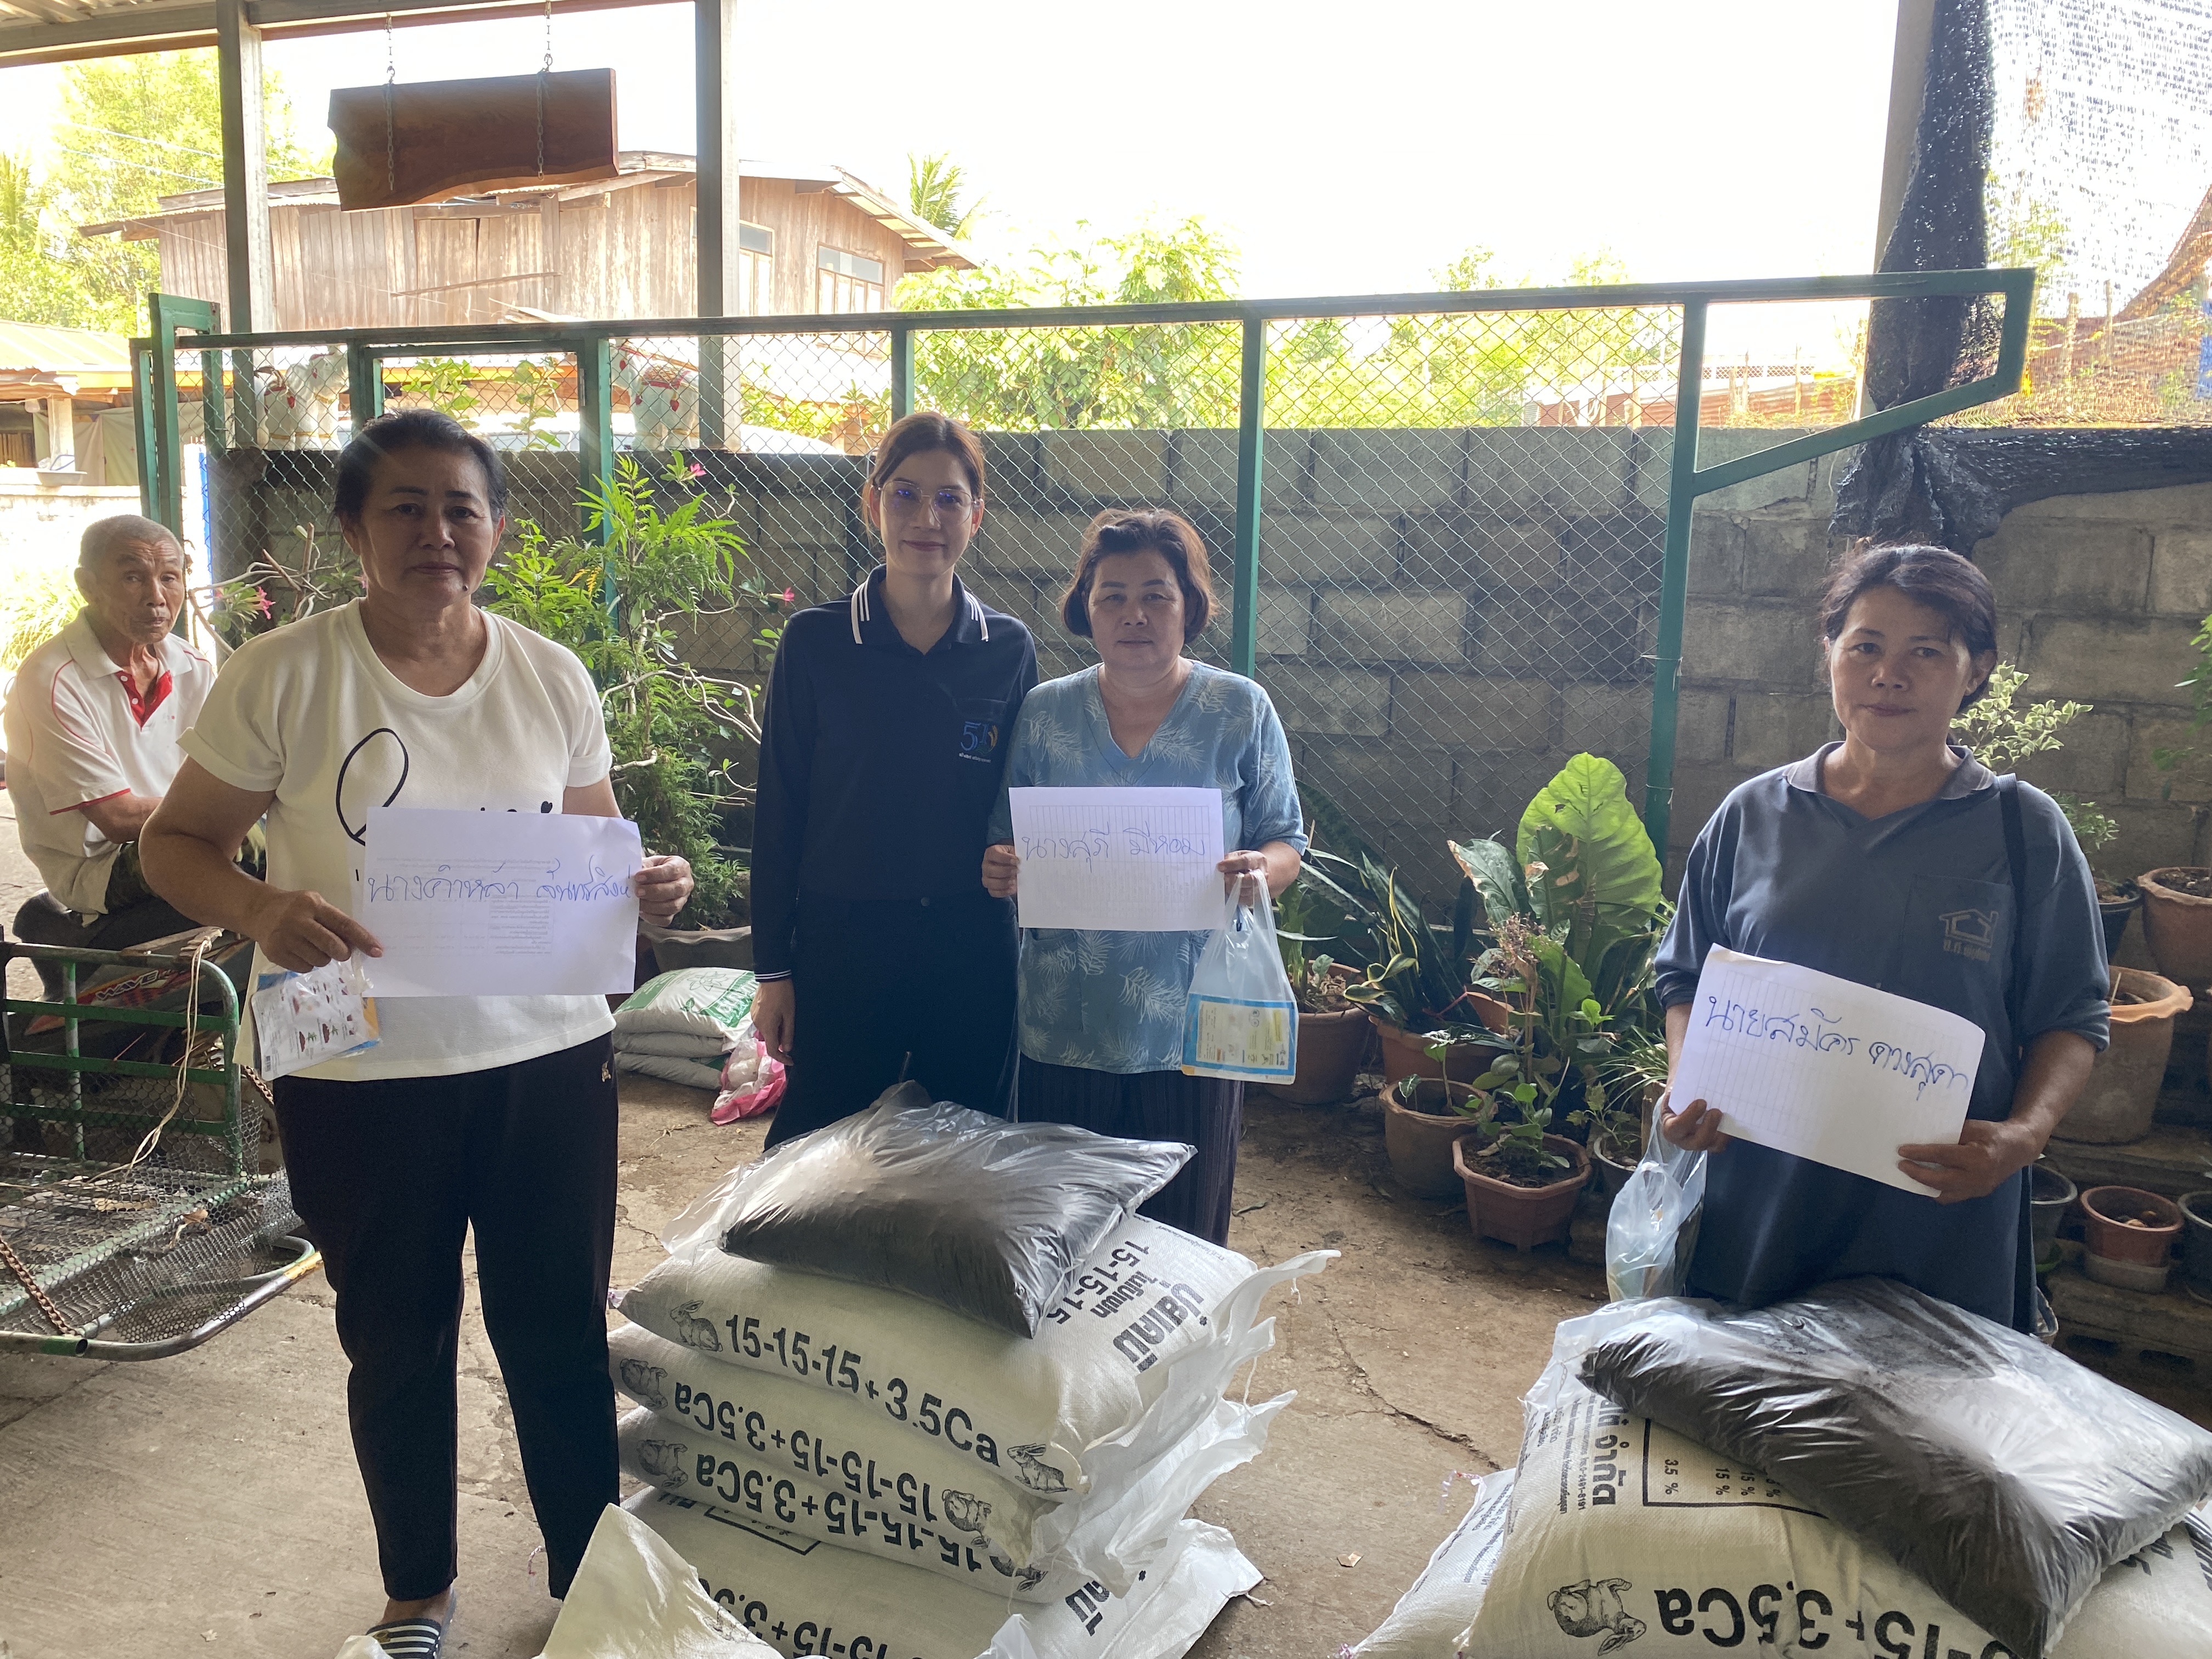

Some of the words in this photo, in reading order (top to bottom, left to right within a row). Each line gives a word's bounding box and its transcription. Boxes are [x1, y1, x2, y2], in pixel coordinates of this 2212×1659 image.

[1122, 821, 1205, 856] มีหอม
[1868, 1041, 1969, 1101] ดวงสุดา
[1113, 1279, 1208, 1374] ปุ๋ยเคมี
[724, 1313, 1001, 1468] 15-15-15+3.5Ca
[674, 1382, 938, 1523] 15-15-15+3.5Ca
[1593, 1435, 1629, 1506] จำกัด
[1664, 1459, 1679, 1475] 3.5
[1716, 1468, 1730, 1480] 15
[1741, 1471, 1755, 1482] 15
[1664, 1482, 1679, 1495] %
[1716, 1485, 1730, 1496] %
[1741, 1486, 1756, 1496] %
